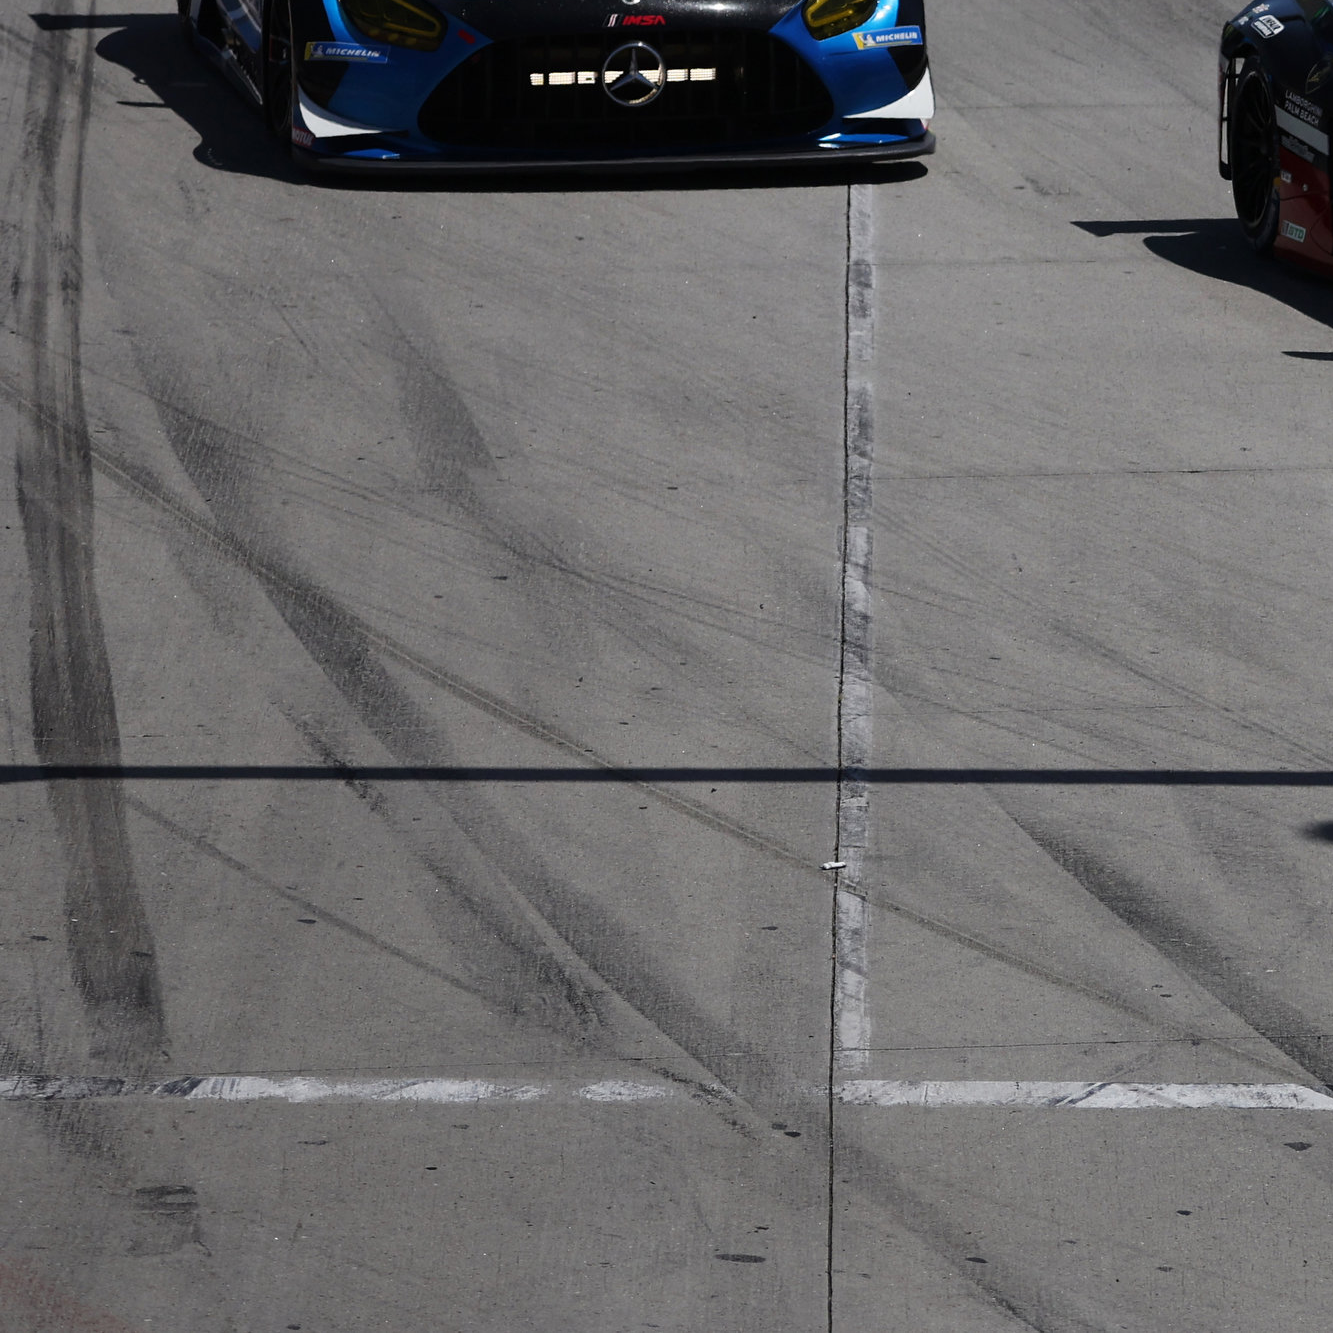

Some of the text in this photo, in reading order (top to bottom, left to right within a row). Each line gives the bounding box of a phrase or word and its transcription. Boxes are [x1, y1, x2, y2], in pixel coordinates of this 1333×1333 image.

[622, 14, 666, 26] IMSA
[875, 30, 918, 41] MICHELIN
[325, 46, 381, 58] MICHELIN
[1285, 100, 1320, 128] PALM BEACH
